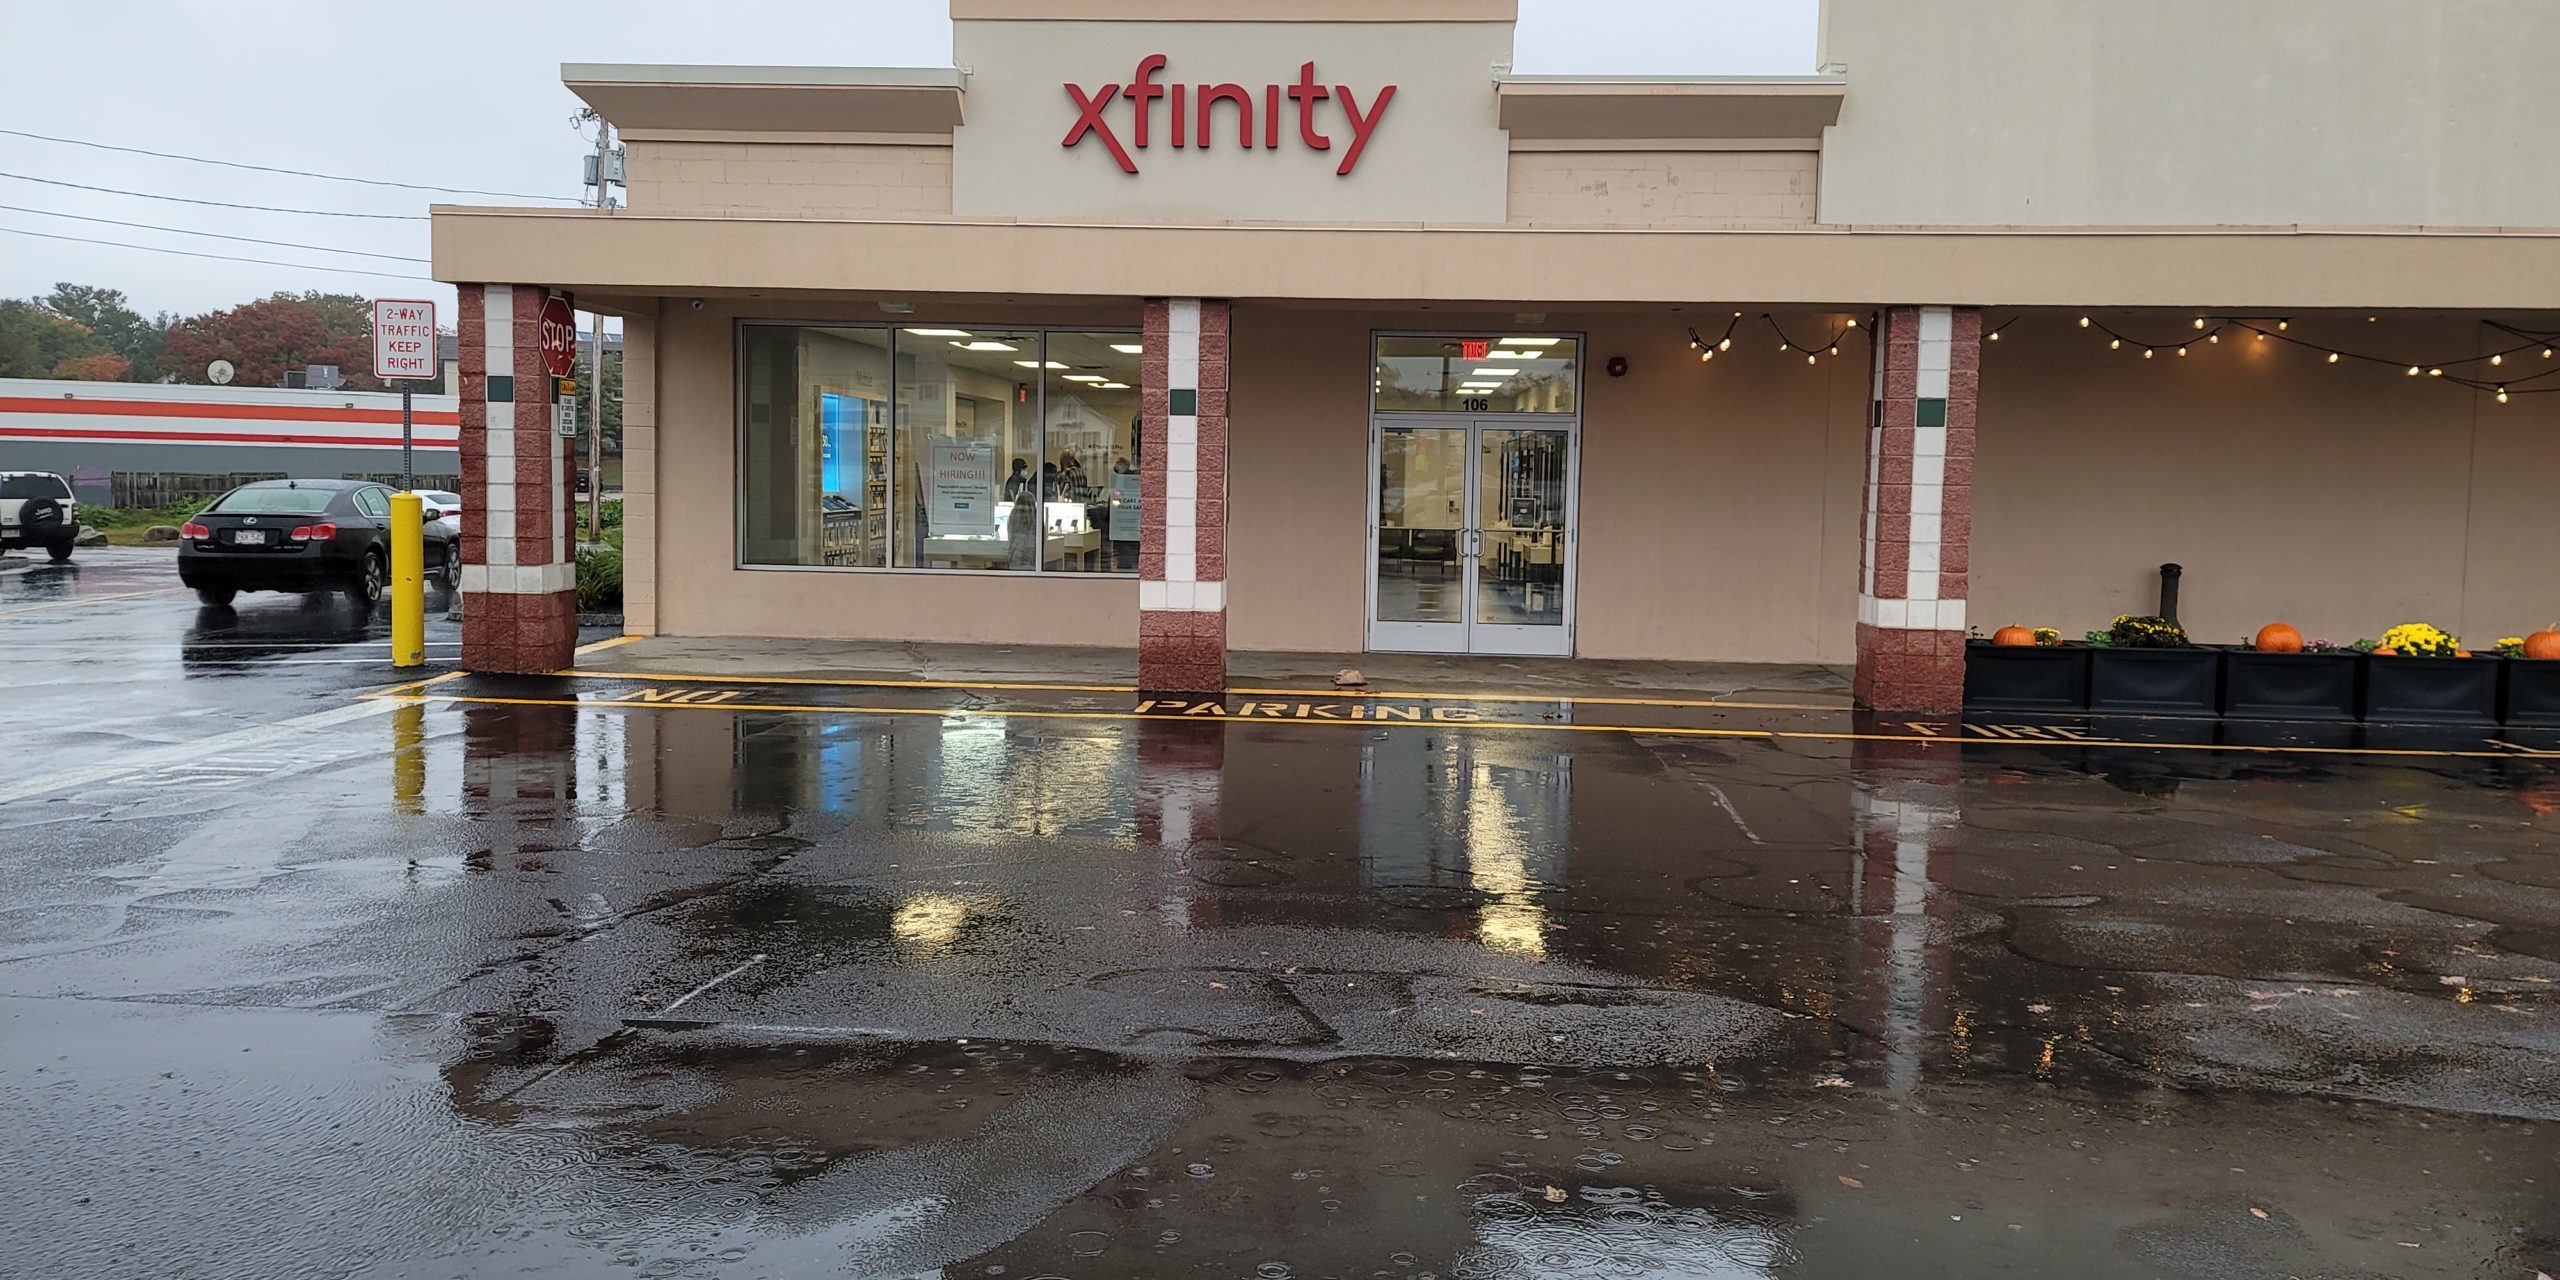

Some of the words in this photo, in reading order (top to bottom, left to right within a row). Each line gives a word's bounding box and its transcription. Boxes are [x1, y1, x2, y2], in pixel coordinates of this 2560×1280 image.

[1061, 54, 1397, 176] xfinity
[386, 308, 424, 321] 2-WAY
[381, 324, 430, 338] TRAFFIC
[542, 321, 574, 353] STOP
[388, 341, 422, 353] KEEP
[387, 357, 425, 370] RIGHT
[1462, 398, 1489, 411] 106
[950, 452, 976, 462] NOW
[614, 688, 741, 704] NO
[1134, 699, 1481, 722] PARKING
[1903, 721, 2122, 741] FIRE
